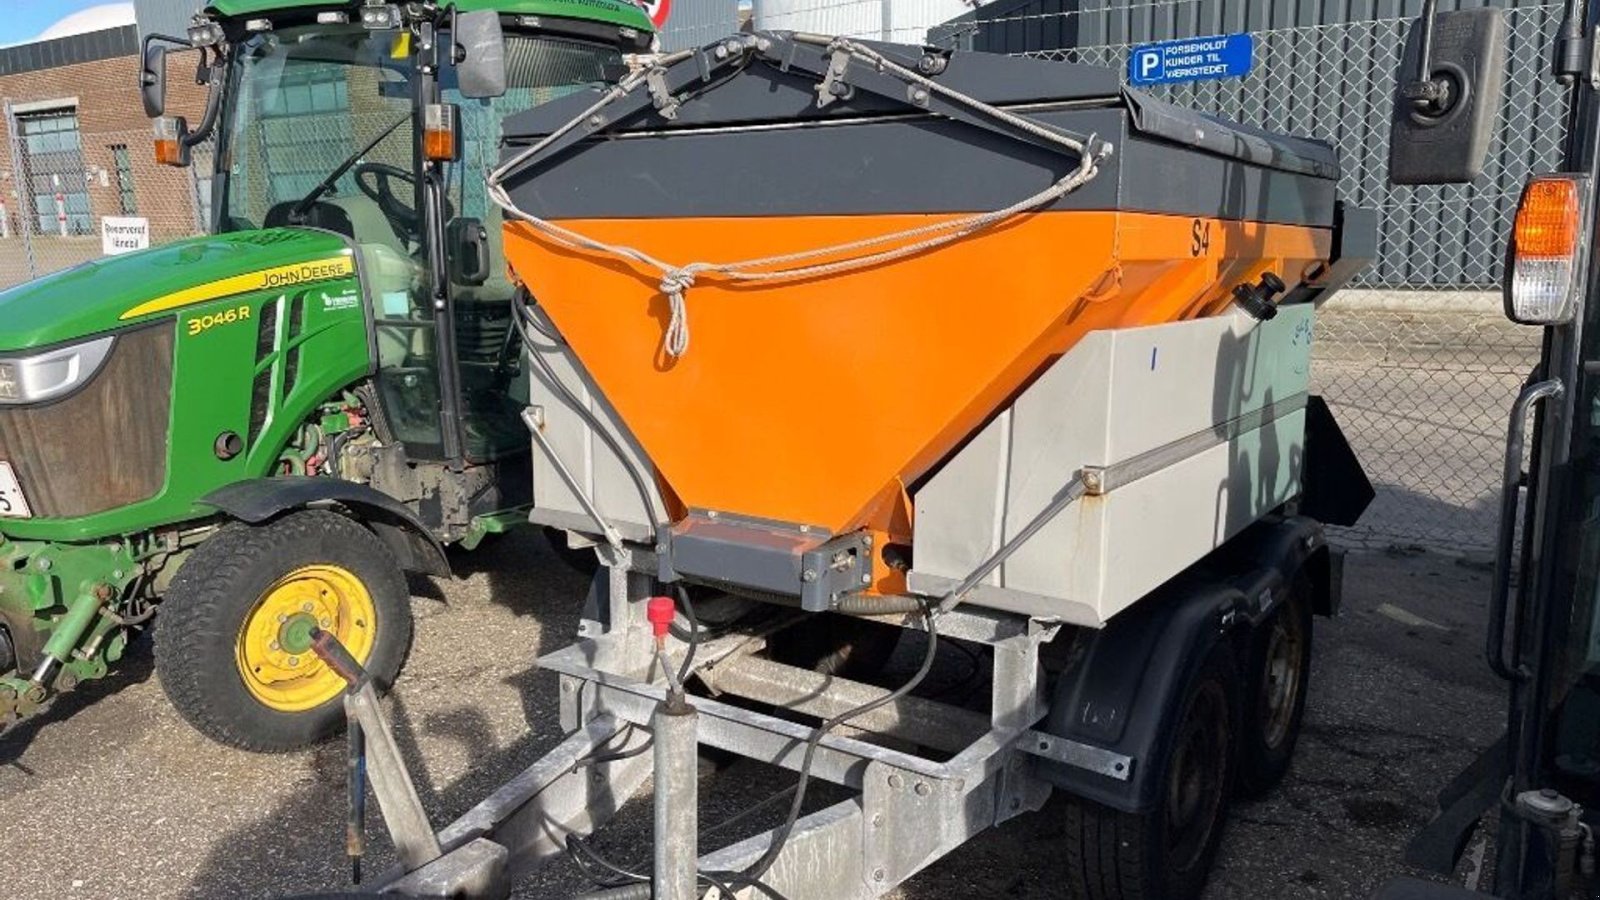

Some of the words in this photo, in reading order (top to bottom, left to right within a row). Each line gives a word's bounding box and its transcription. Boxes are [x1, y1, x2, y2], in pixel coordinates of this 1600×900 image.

[1142, 53, 1159, 77] P
[1165, 54, 1203, 67] KUNDER
[1207, 53, 1221, 62] TIL
[1166, 64, 1228, 78] VÆRKSTEDET
[1192, 219, 1210, 257] S4
[260, 270, 300, 287] JOHN
[300, 263, 345, 280] DEERE
